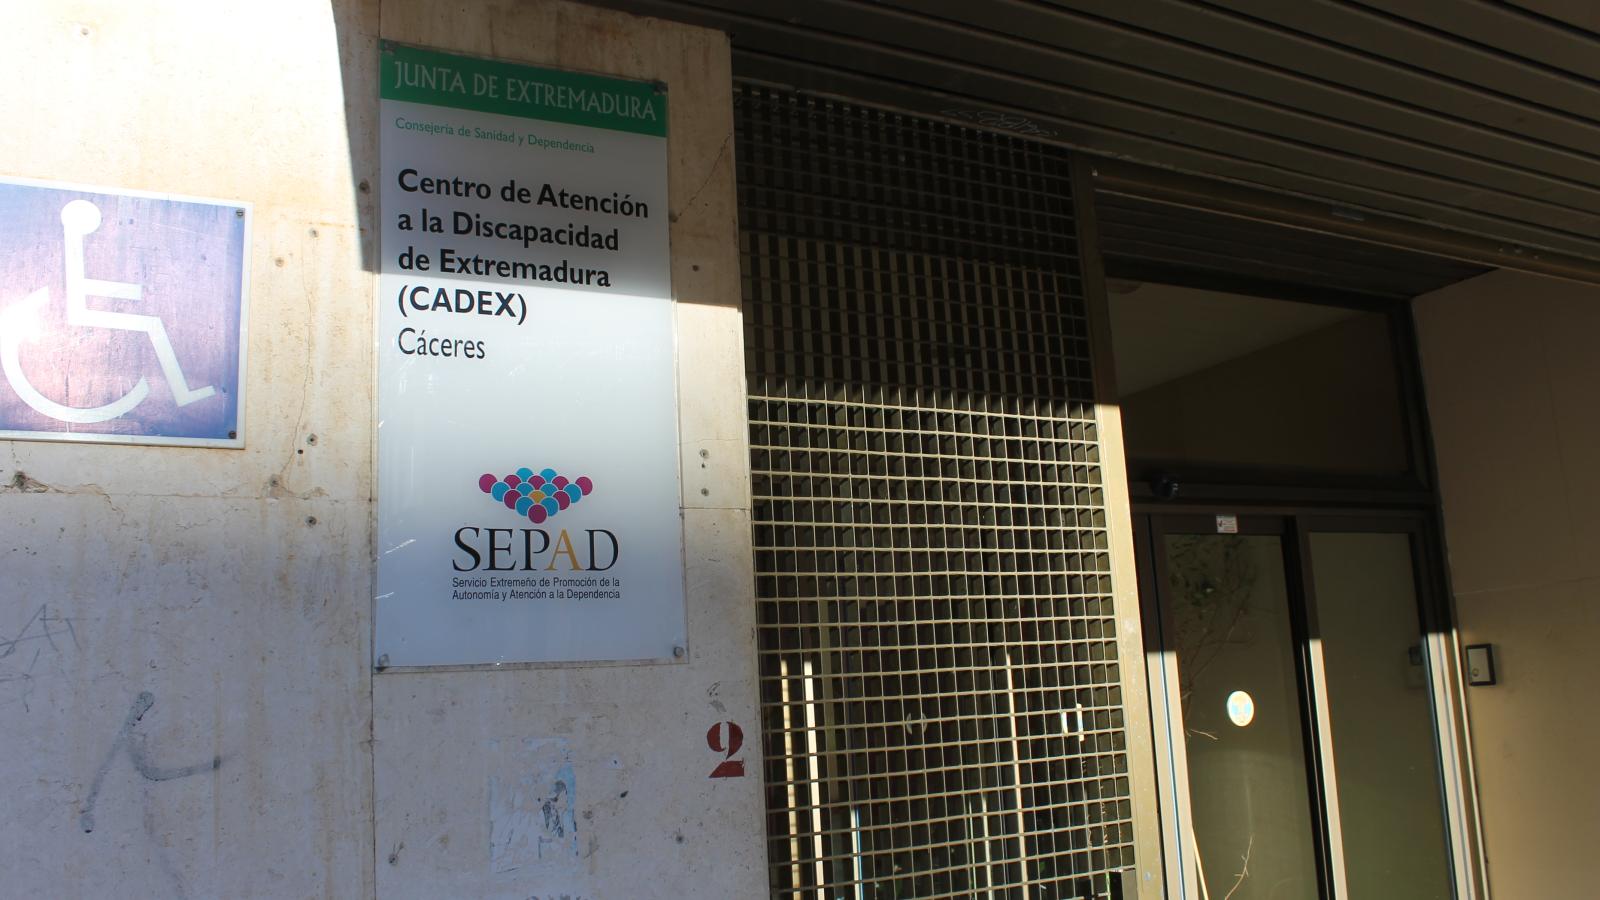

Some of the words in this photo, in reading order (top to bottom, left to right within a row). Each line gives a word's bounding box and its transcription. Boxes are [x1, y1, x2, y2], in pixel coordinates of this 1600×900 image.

[394, 61, 466, 93] JUNTA
[473, 74, 499, 98] DE
[506, 78, 657, 121] EXTREMADURA
[395, 117, 453, 136] Consejería
[457, 126, 471, 137] de
[474, 127, 515, 143] Sanidad
[518, 135, 525, 146] y
[528, 134, 595, 153] Dependencia
[398, 169, 491, 199] Centro
[500, 180, 531, 204] de
[537, 184, 648, 218] Atención
[398, 213, 412, 231] a
[422, 209, 444, 233] la
[453, 211, 619, 251] Discapacidad
[398, 246, 430, 271] de
[440, 249, 611, 287] Extremadura
[398, 285, 527, 325] (CADEX)
[398, 327, 486, 359] Cáceres
[452, 526, 619, 572] SEPAD
[452, 577, 487, 588] Servicio
[490, 577, 537, 587] Extremeño
[539, 577, 550, 587] de
[553, 576, 597, 587] Promoción
[599, 577, 610, 587] de
[612, 577, 620, 587] la
[452, 588, 500, 600] Autonomía
[502, 590, 507, 602] y
[509, 588, 547, 599] Atención
[548, 591, 555, 599] a
[556, 588, 564, 599] la
[566, 588, 620, 599] Dependencia
[706, 720, 745, 778] 2
